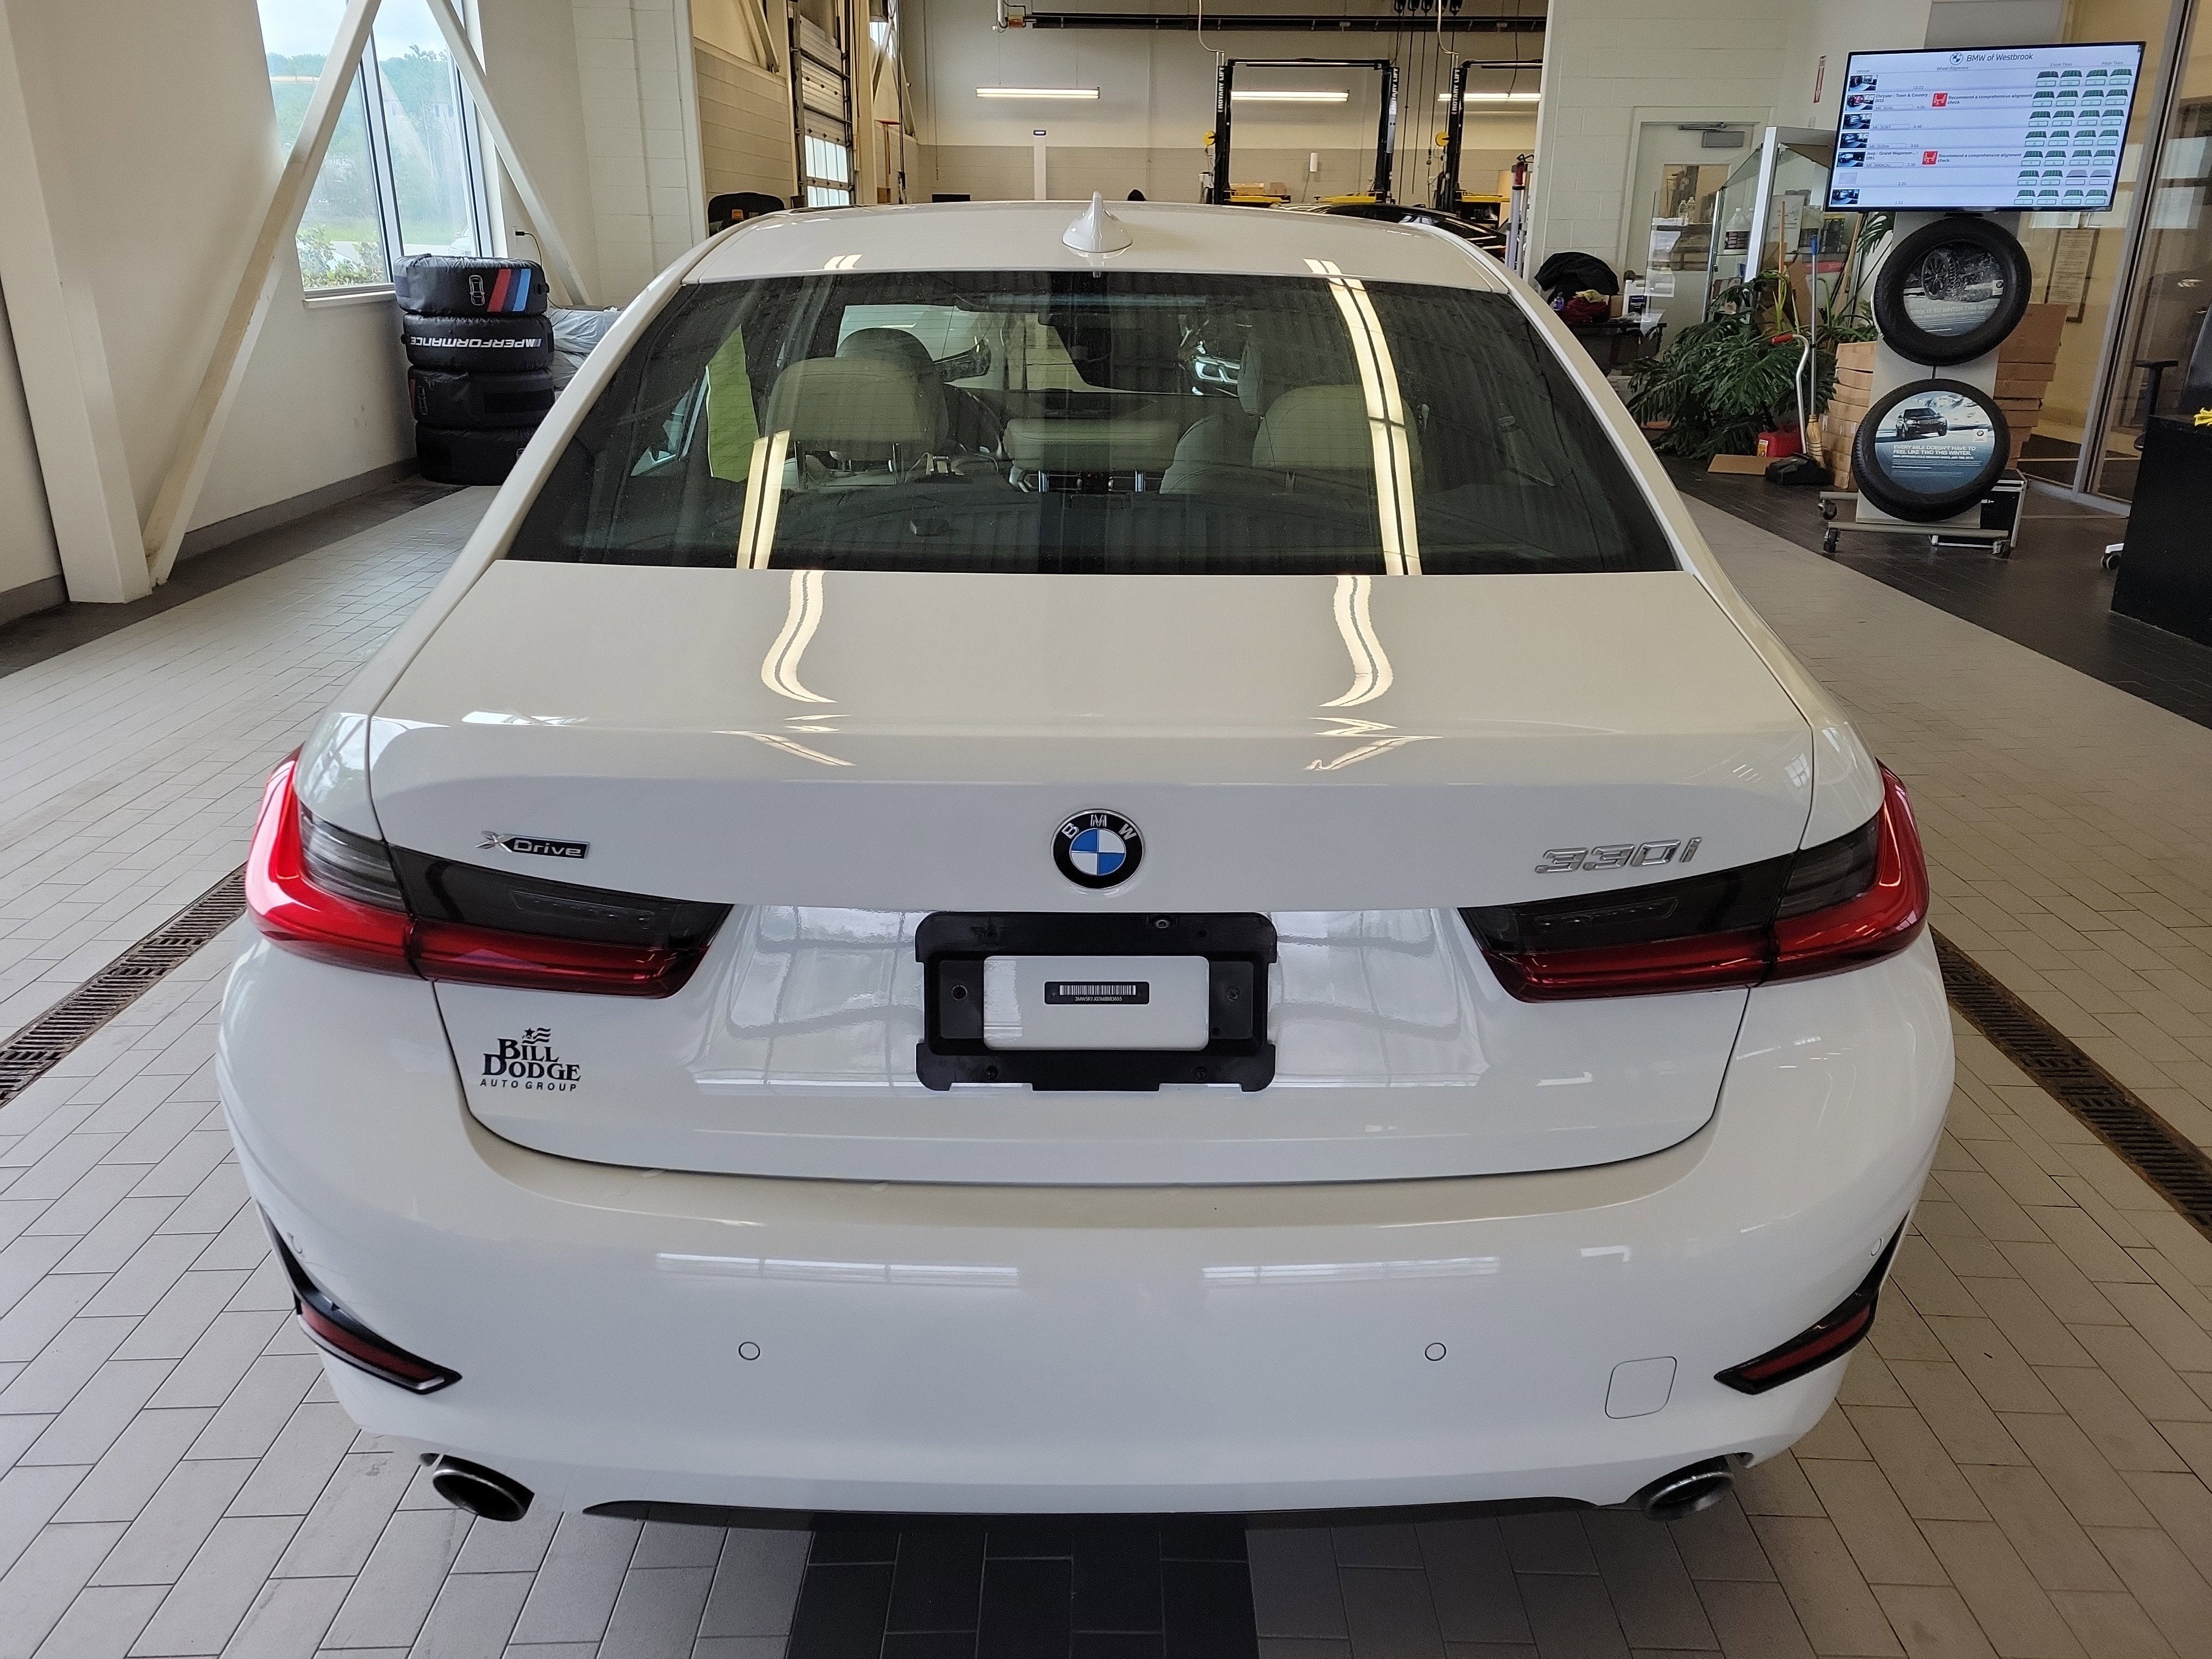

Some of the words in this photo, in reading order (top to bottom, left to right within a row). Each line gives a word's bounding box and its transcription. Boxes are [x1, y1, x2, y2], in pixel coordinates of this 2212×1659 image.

[1996, 53, 2033, 61] Westbrook
[1535, 837, 1703, 874] 330i
[498, 1038, 560, 1063] BILL
[482, 1053, 582, 1082] DODGE
[480, 1079, 519, 1088] AUTO
[525, 1081, 577, 1092] GROUP
